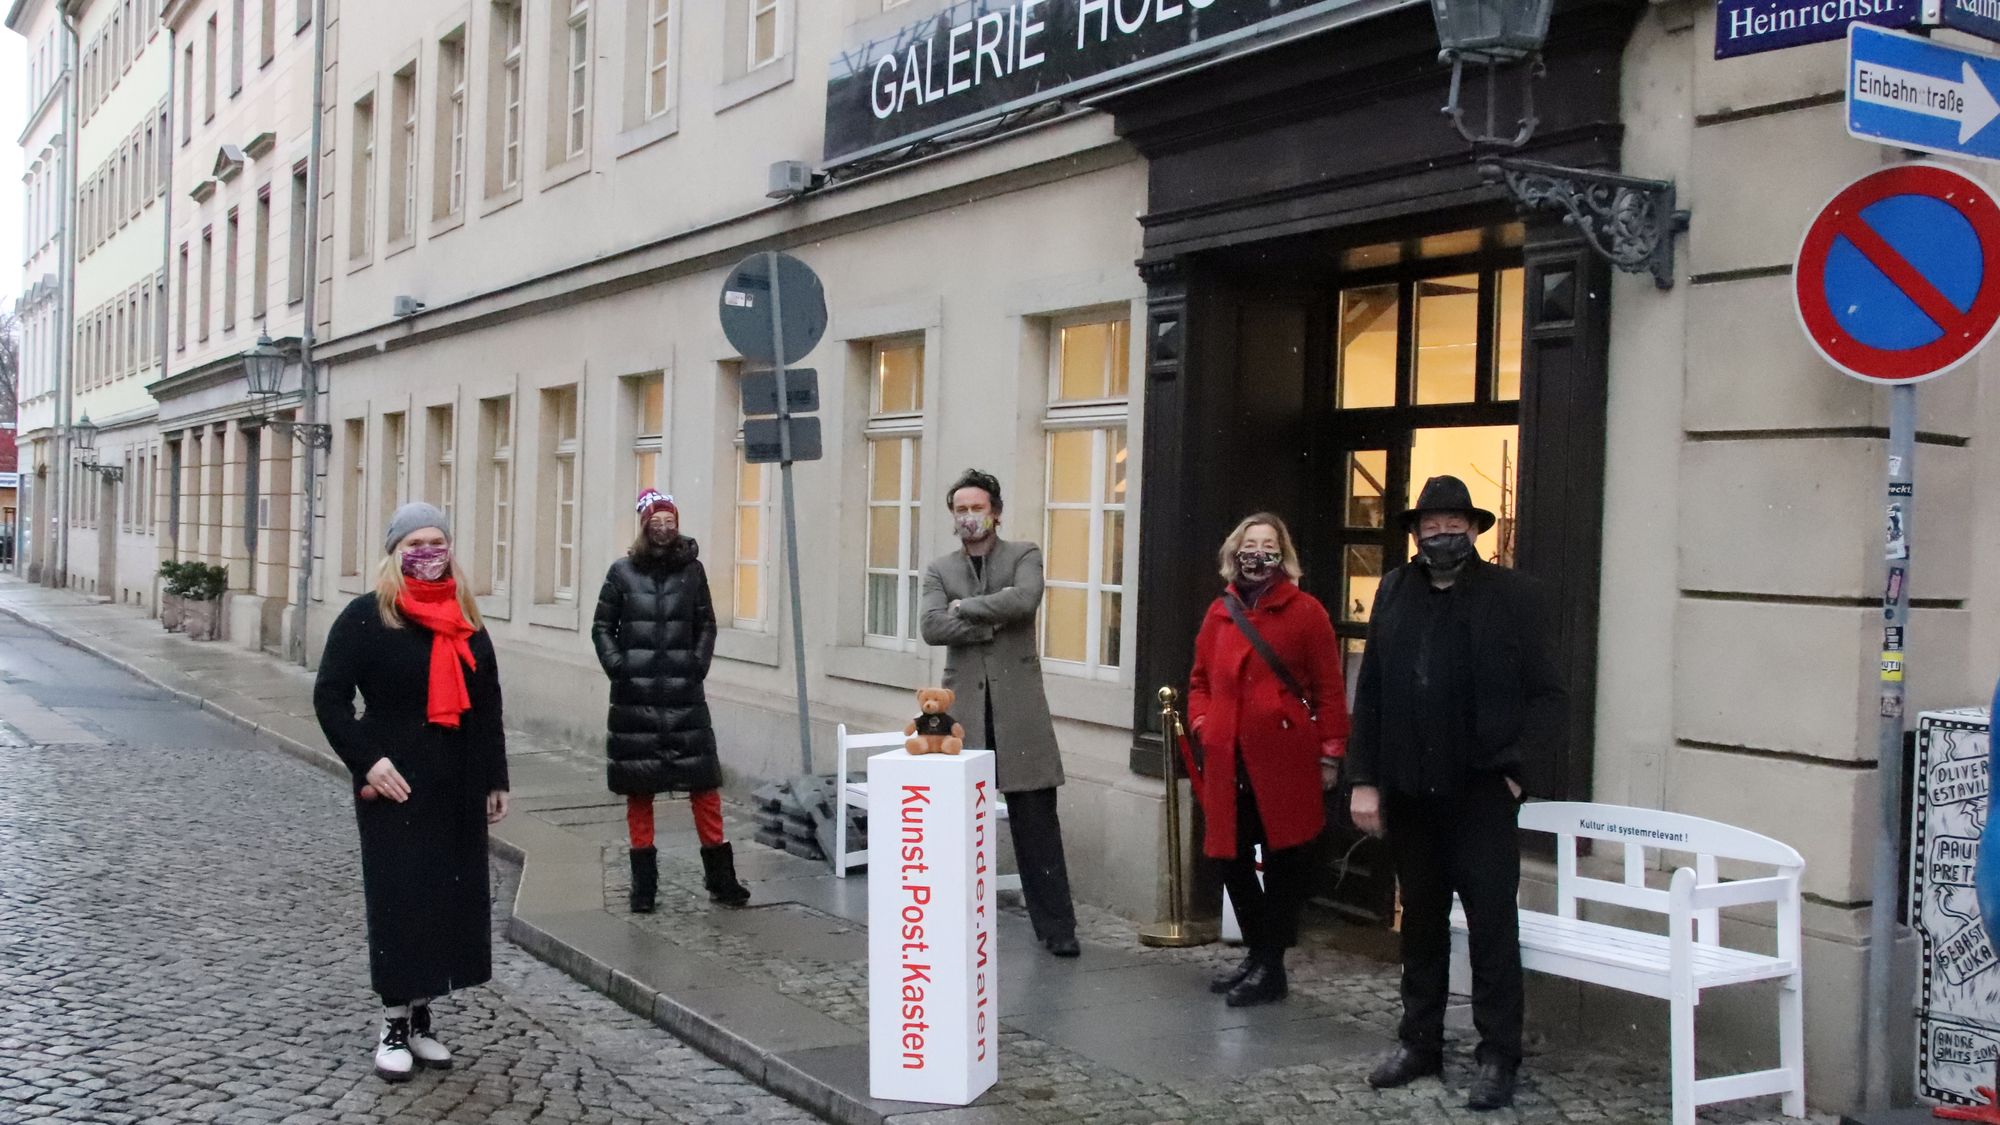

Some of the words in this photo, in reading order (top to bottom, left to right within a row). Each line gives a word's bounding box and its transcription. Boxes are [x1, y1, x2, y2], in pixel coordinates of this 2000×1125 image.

[1729, 0, 1904, 39] Heinrichstr.
[871, 0, 1046, 120] GALERIE
[1859, 70, 1964, 113] Einbahntraße
[1938, 760, 1988, 783] OLIVER
[1579, 819, 1605, 831] Kultur
[1606, 824, 1617, 833] ist
[1618, 826, 1683, 842] systemrelevant
[901, 785, 932, 1070] Kunst.Post.Kasten
[975, 780, 988, 1062] Kinder.Malen
[1938, 923, 1985, 969] SEBAST
[1956, 945, 1992, 978] LUKA
